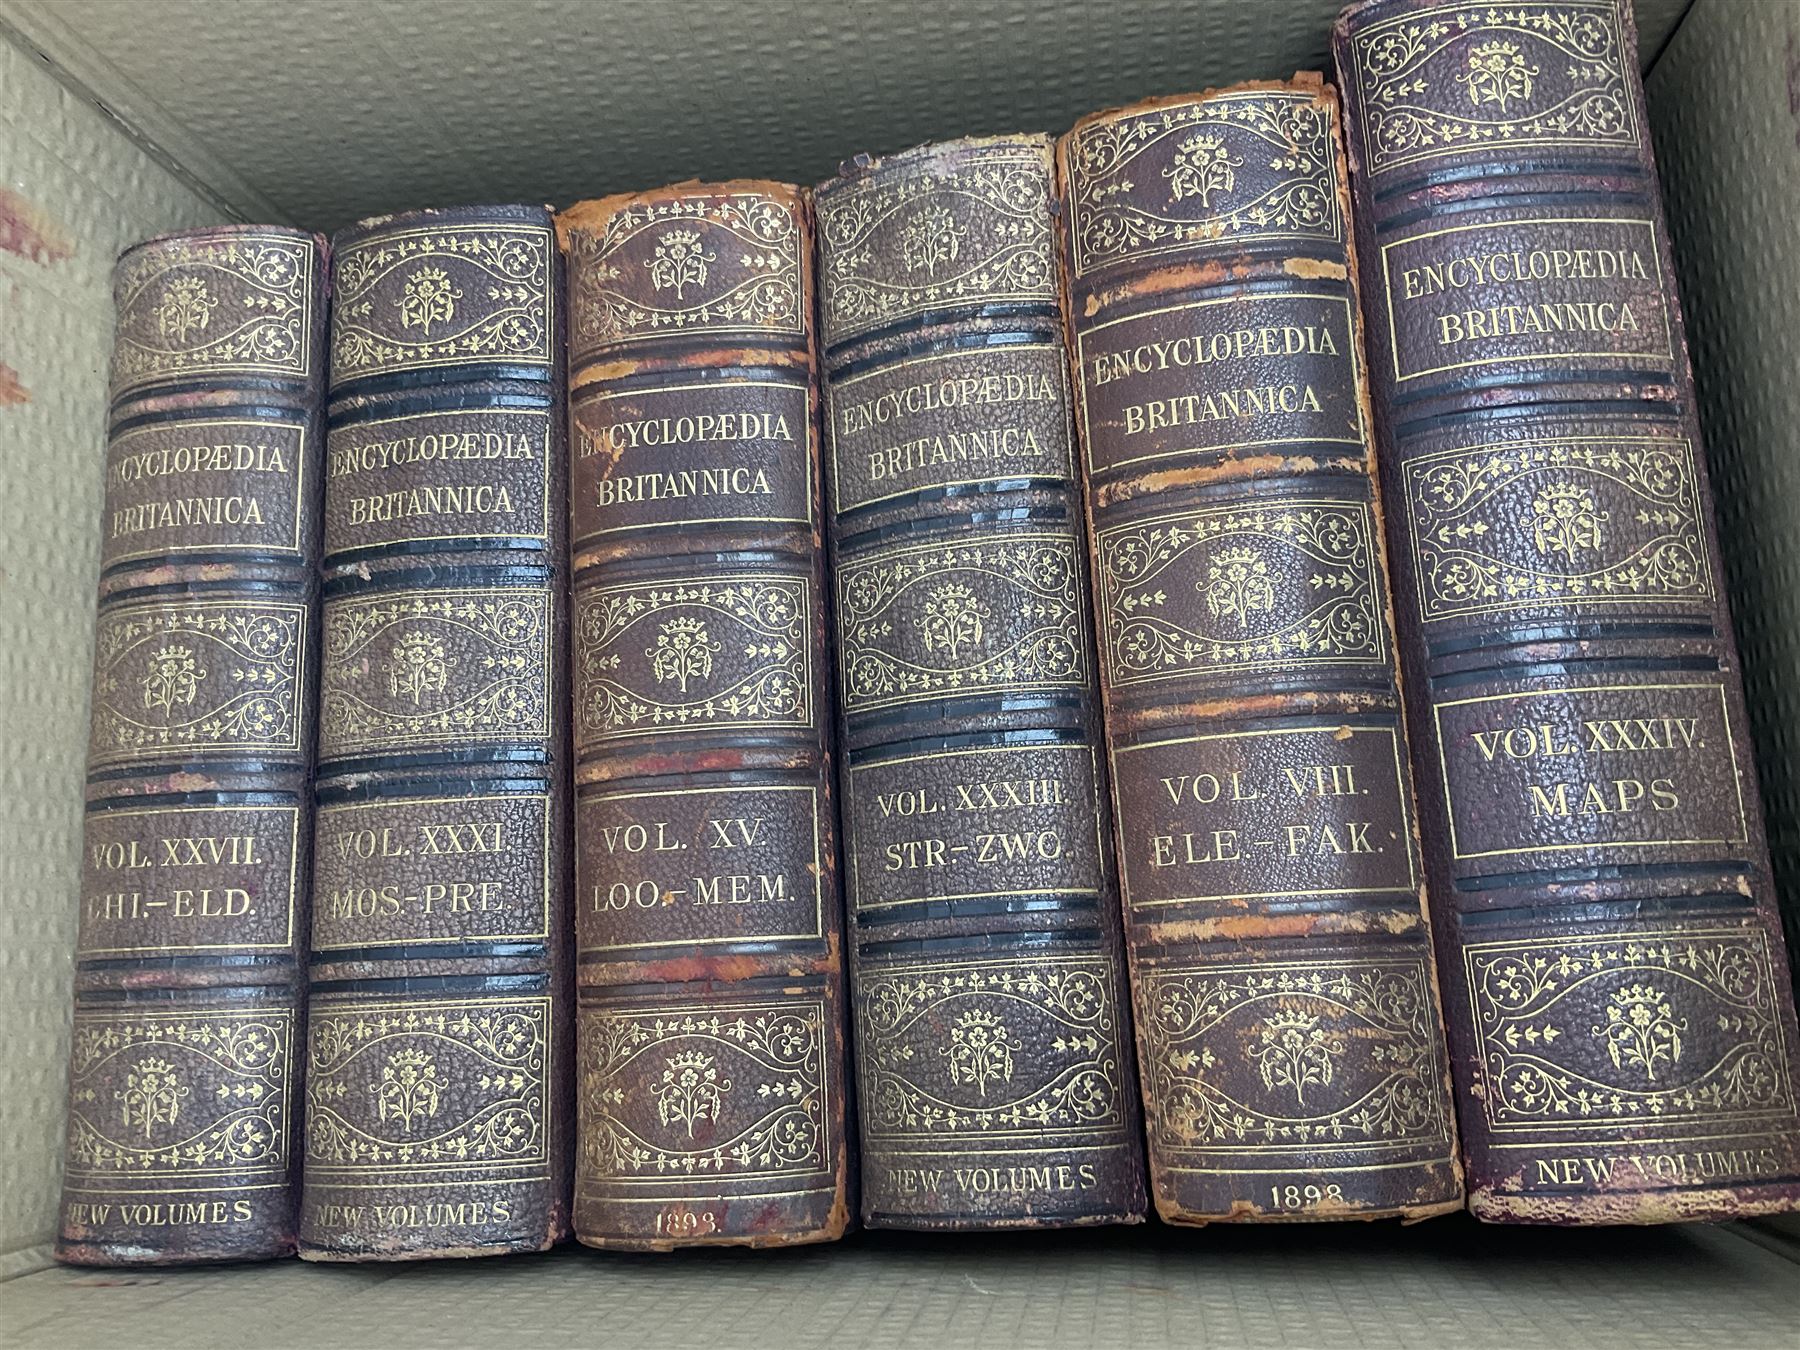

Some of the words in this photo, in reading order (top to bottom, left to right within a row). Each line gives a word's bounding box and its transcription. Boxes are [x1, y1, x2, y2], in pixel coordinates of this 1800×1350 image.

[1402, 250, 1649, 300] ENCYCLOPÆDIA
[1438, 301, 1640, 345] BRITANNICA
[1094, 325, 1340, 385] ENCYCLOPÆDIA
[843, 374, 1057, 435] ENCYCLOPÆDIA
[1122, 385, 1324, 436] BRITANNICA
[331, 433, 535, 478] ENCYCLOPÆDIA
[868, 428, 1043, 481] BRITANNICA
[350, 485, 516, 526] BRITANNICA
[597, 467, 772, 507] BRITANNICA
[112, 497, 265, 539] BRITANNICA
[1473, 723, 1578, 762] VOL.
[1585, 717, 1705, 753] XXXIV.
[876, 788, 946, 819] VOL.
[955, 778, 1070, 812] XXXIII.
[1281, 764, 1370, 798] VIII.
[1529, 778, 1680, 819] MAPS
[92, 840, 152, 871] VOL.
[160, 836, 262, 867] XXVII.
[337, 828, 411, 859] VOL.
[419, 822, 512, 856] XXXI.
[602, 821, 688, 854] VOL.
[709, 817, 767, 850] XV.
[888, 1168, 944, 1193] NEW
[953, 1164, 1098, 1193] VOLUMES
[1536, 1155, 1617, 1185] NEW
[1629, 1148, 1780, 1184] VOLUMES
[120, 1199, 253, 1226] VOLUMES
[314, 1204, 368, 1228] NEW
[374, 1199, 511, 1228] VOLUMES
[1271, 1184, 1344, 1209] 1898
